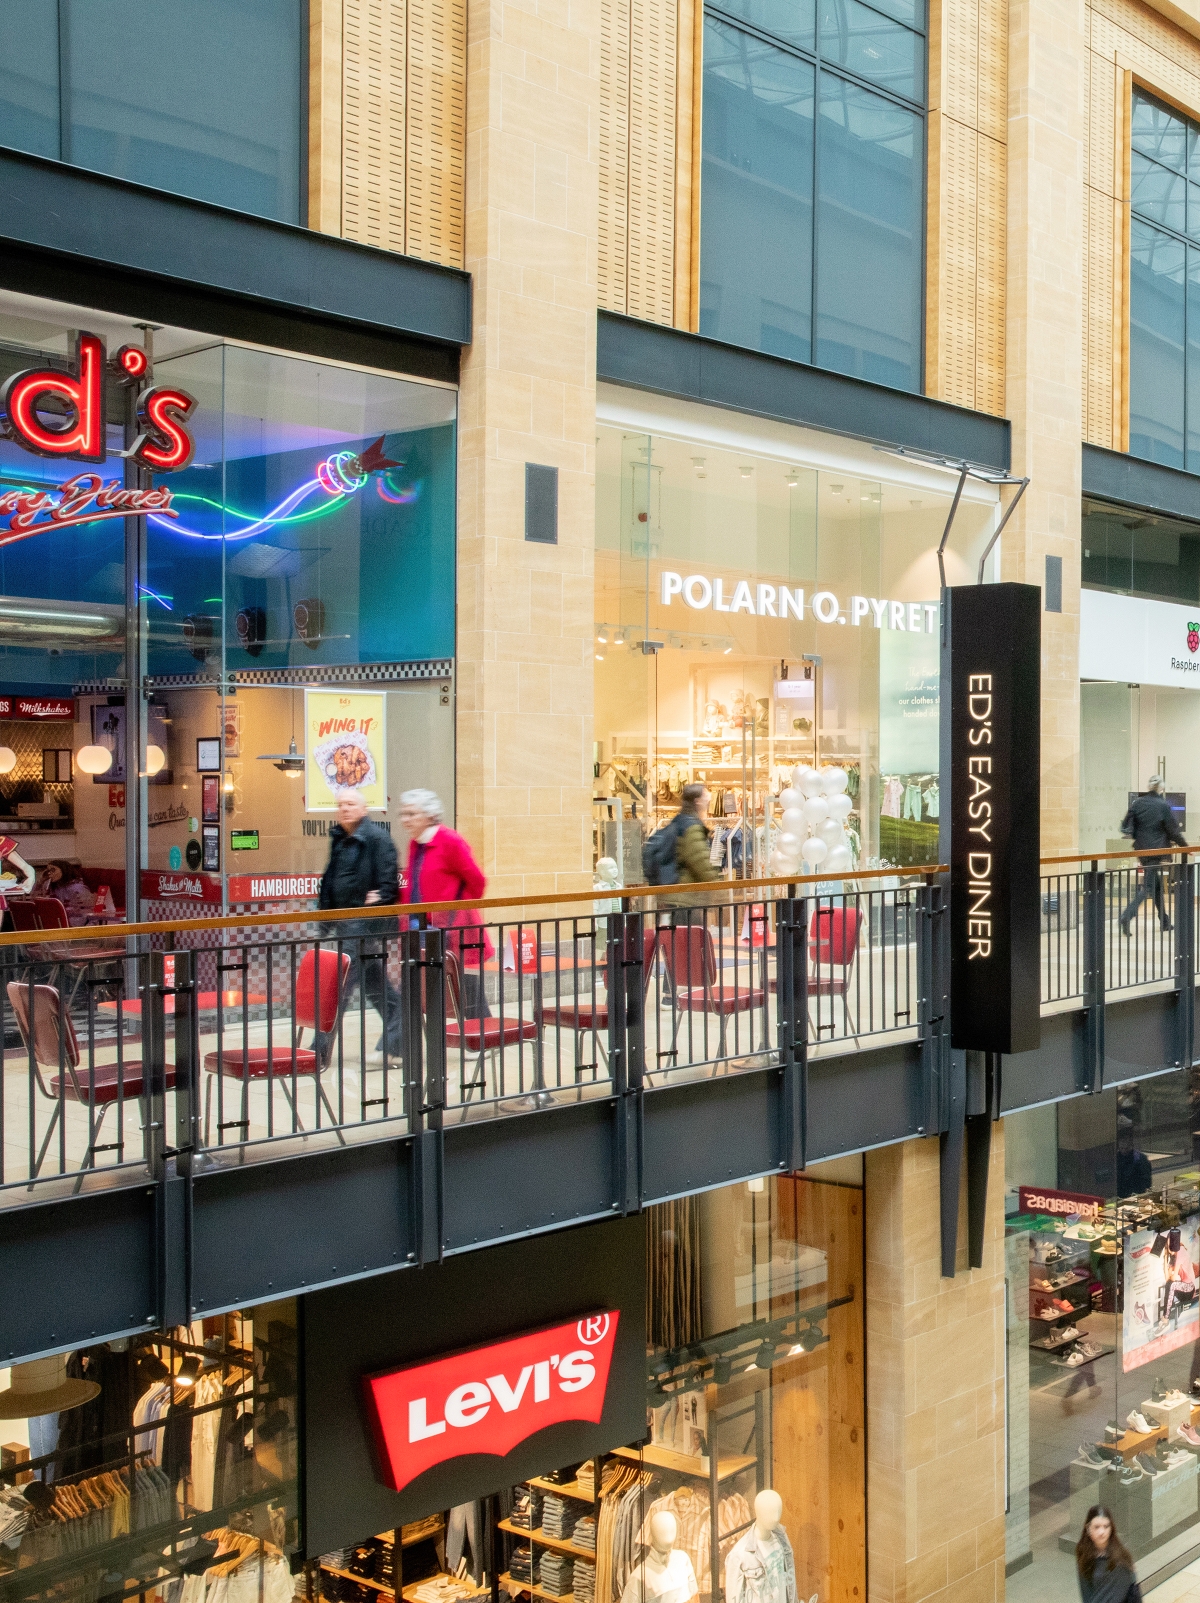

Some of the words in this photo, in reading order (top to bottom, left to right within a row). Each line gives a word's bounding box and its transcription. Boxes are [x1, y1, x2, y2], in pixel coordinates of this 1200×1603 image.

[2, 331, 198, 473] d's
[52, 472, 175, 520] Diner
[661, 571, 804, 620] POLARN
[812, 591, 846, 625] O.
[851, 595, 937, 634] PYRET
[19, 702, 71, 717] Milkshakes
[318, 717, 356, 737] WING
[360, 717, 373, 736] IT
[911, 695, 933, 705] clothes
[969, 674, 992, 745] ED'S
[969, 757, 992, 842] EASY
[969, 853, 992, 960] DINER
